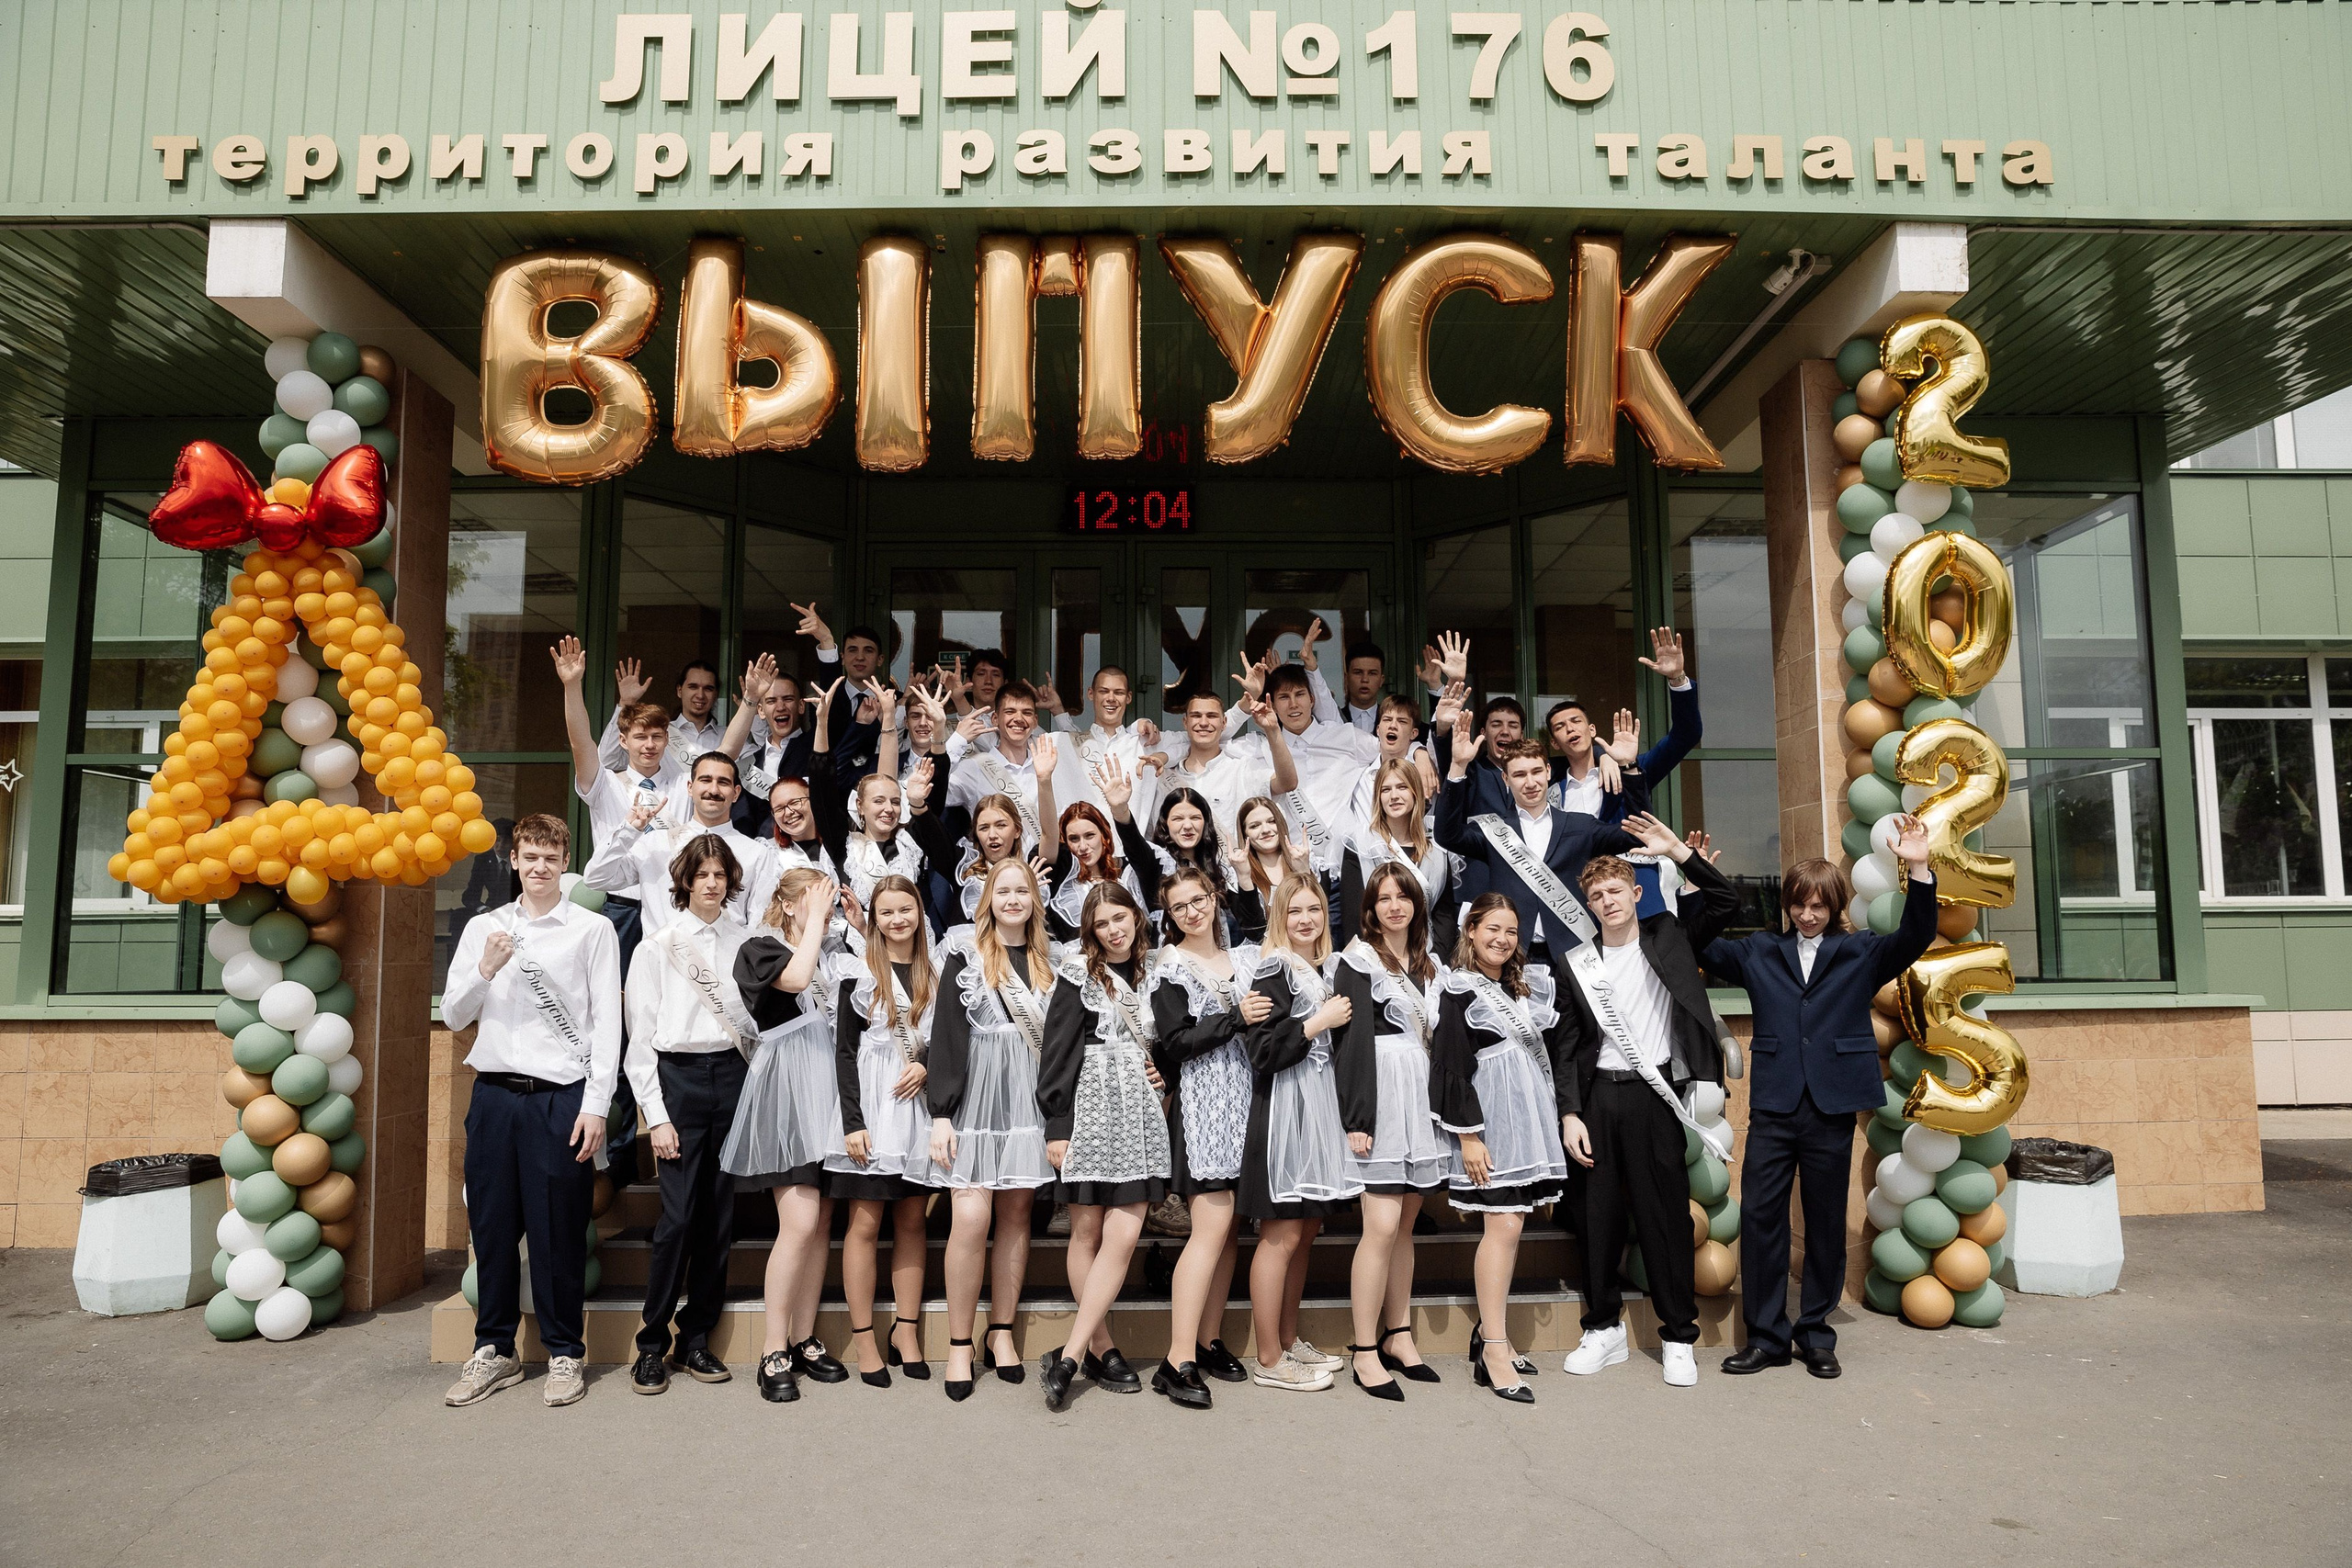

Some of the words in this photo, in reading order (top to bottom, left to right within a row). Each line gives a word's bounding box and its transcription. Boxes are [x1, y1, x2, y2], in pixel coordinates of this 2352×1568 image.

[600, 0, 1126, 117] ЛИЦЕЙ
[153, 130, 832, 196] территория
[941, 129, 1492, 189] развития
[1594, 132, 2055, 186] таланта
[480, 231, 1737, 486] ВЫПУСК
[1074, 491, 1191, 529] 12:04
[1492, 827, 1555, 894] Выпускник
[1549, 892, 1585, 925] 2025
[518, 958, 583, 1046] Выпускник
[1590, 980, 1644, 1071] Выпускник
